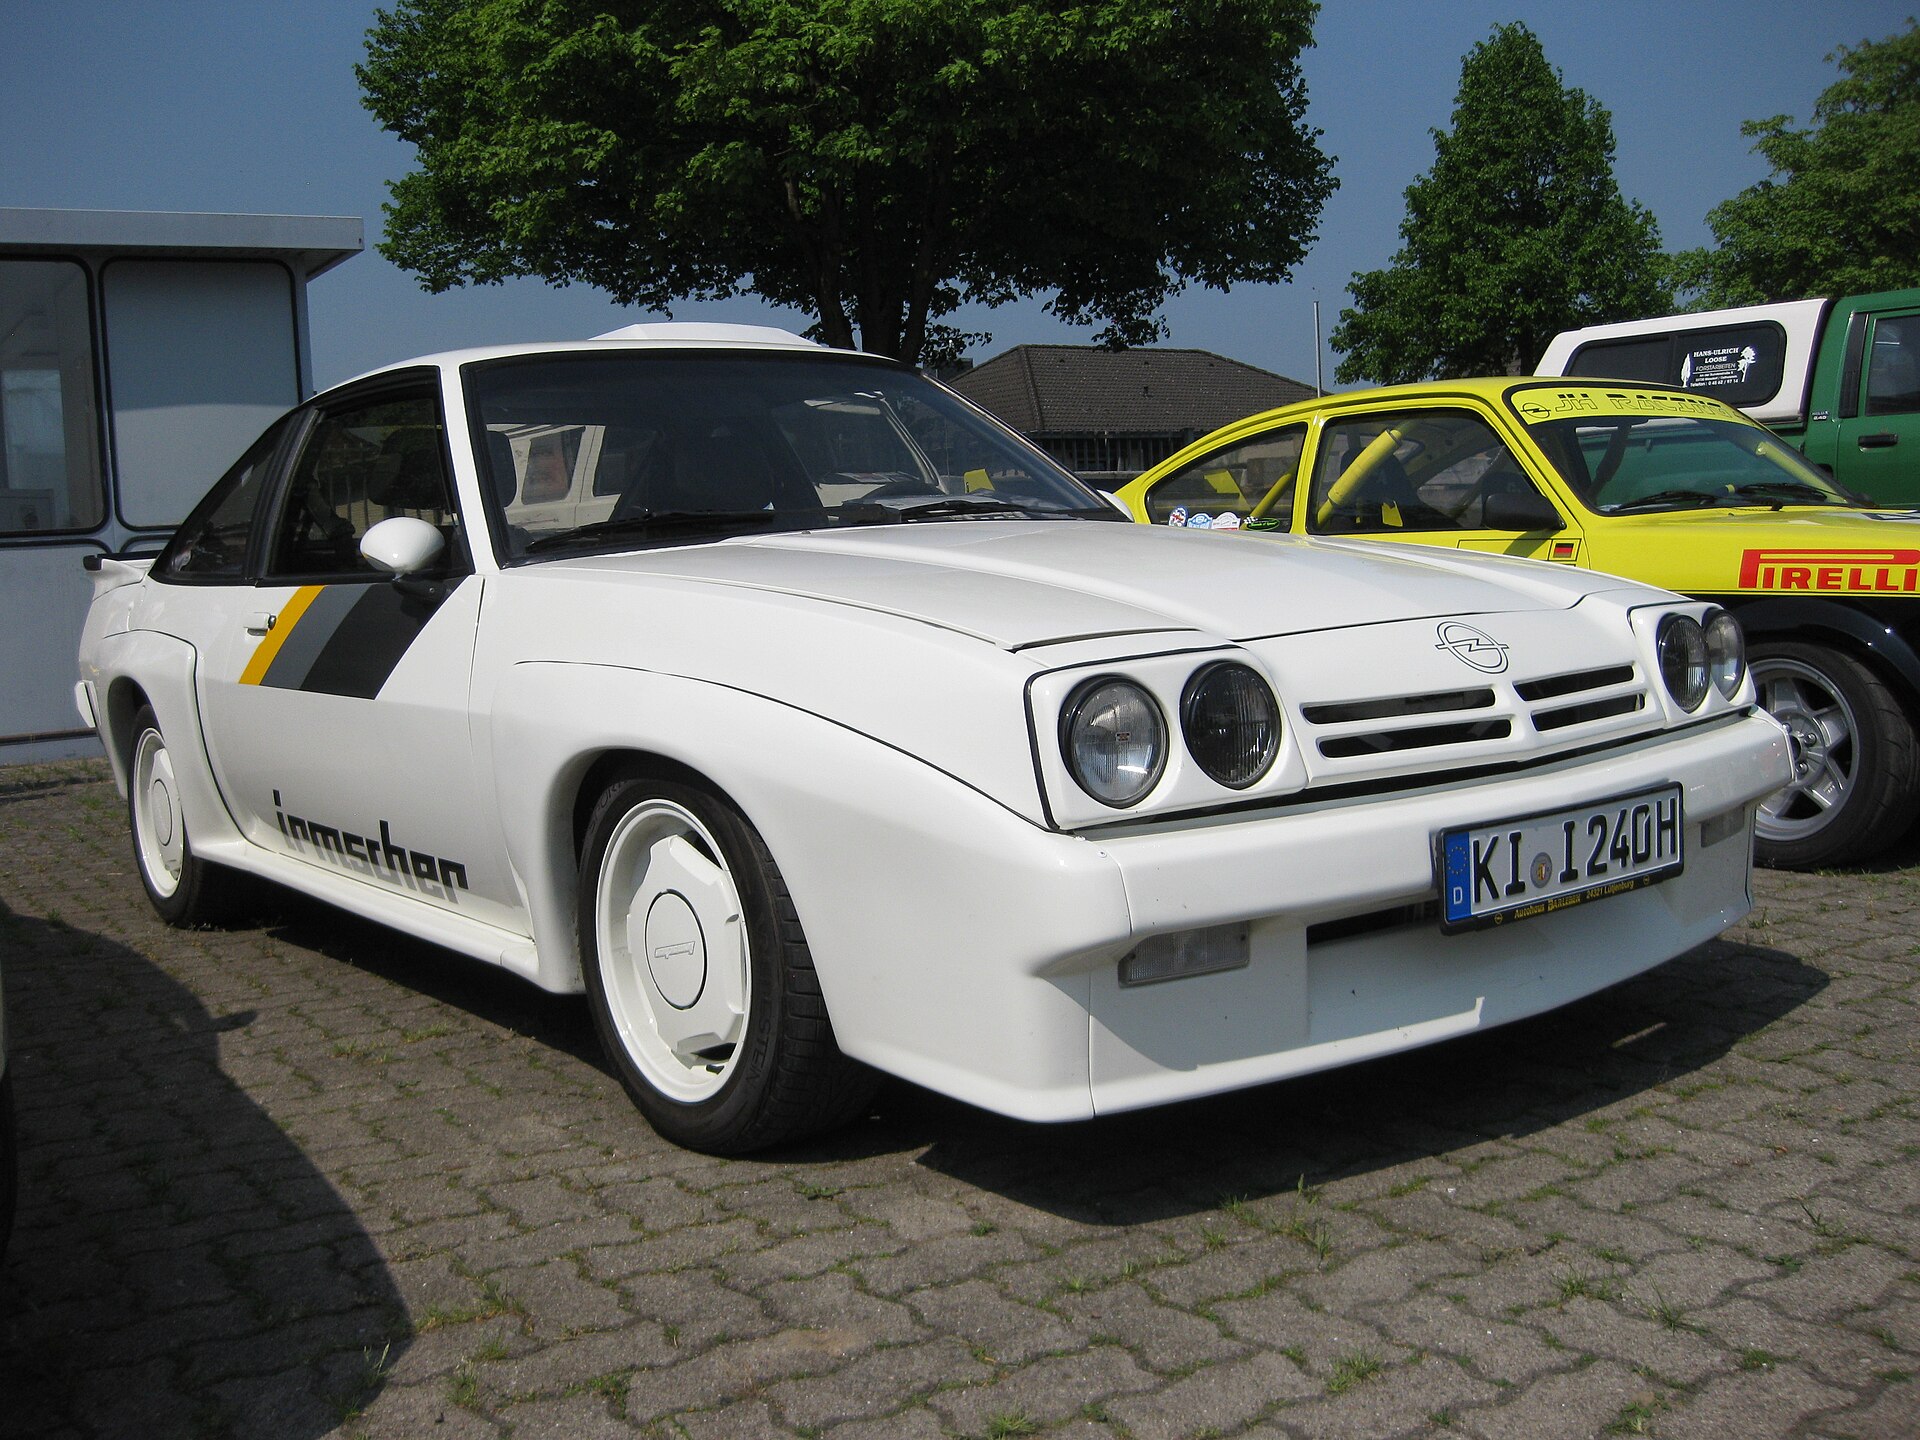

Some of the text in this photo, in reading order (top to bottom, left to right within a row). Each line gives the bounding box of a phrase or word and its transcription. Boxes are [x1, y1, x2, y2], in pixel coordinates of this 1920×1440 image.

[1693, 347, 1740, 358] HANS-ULRICH
[1704, 356, 1728, 364] LOOSE
[1738, 549, 1920, 591] PIRELLI
[272, 788, 470, 904] irmscher
[1472, 830, 1526, 904] KI
[1453, 886, 1463, 905] D
